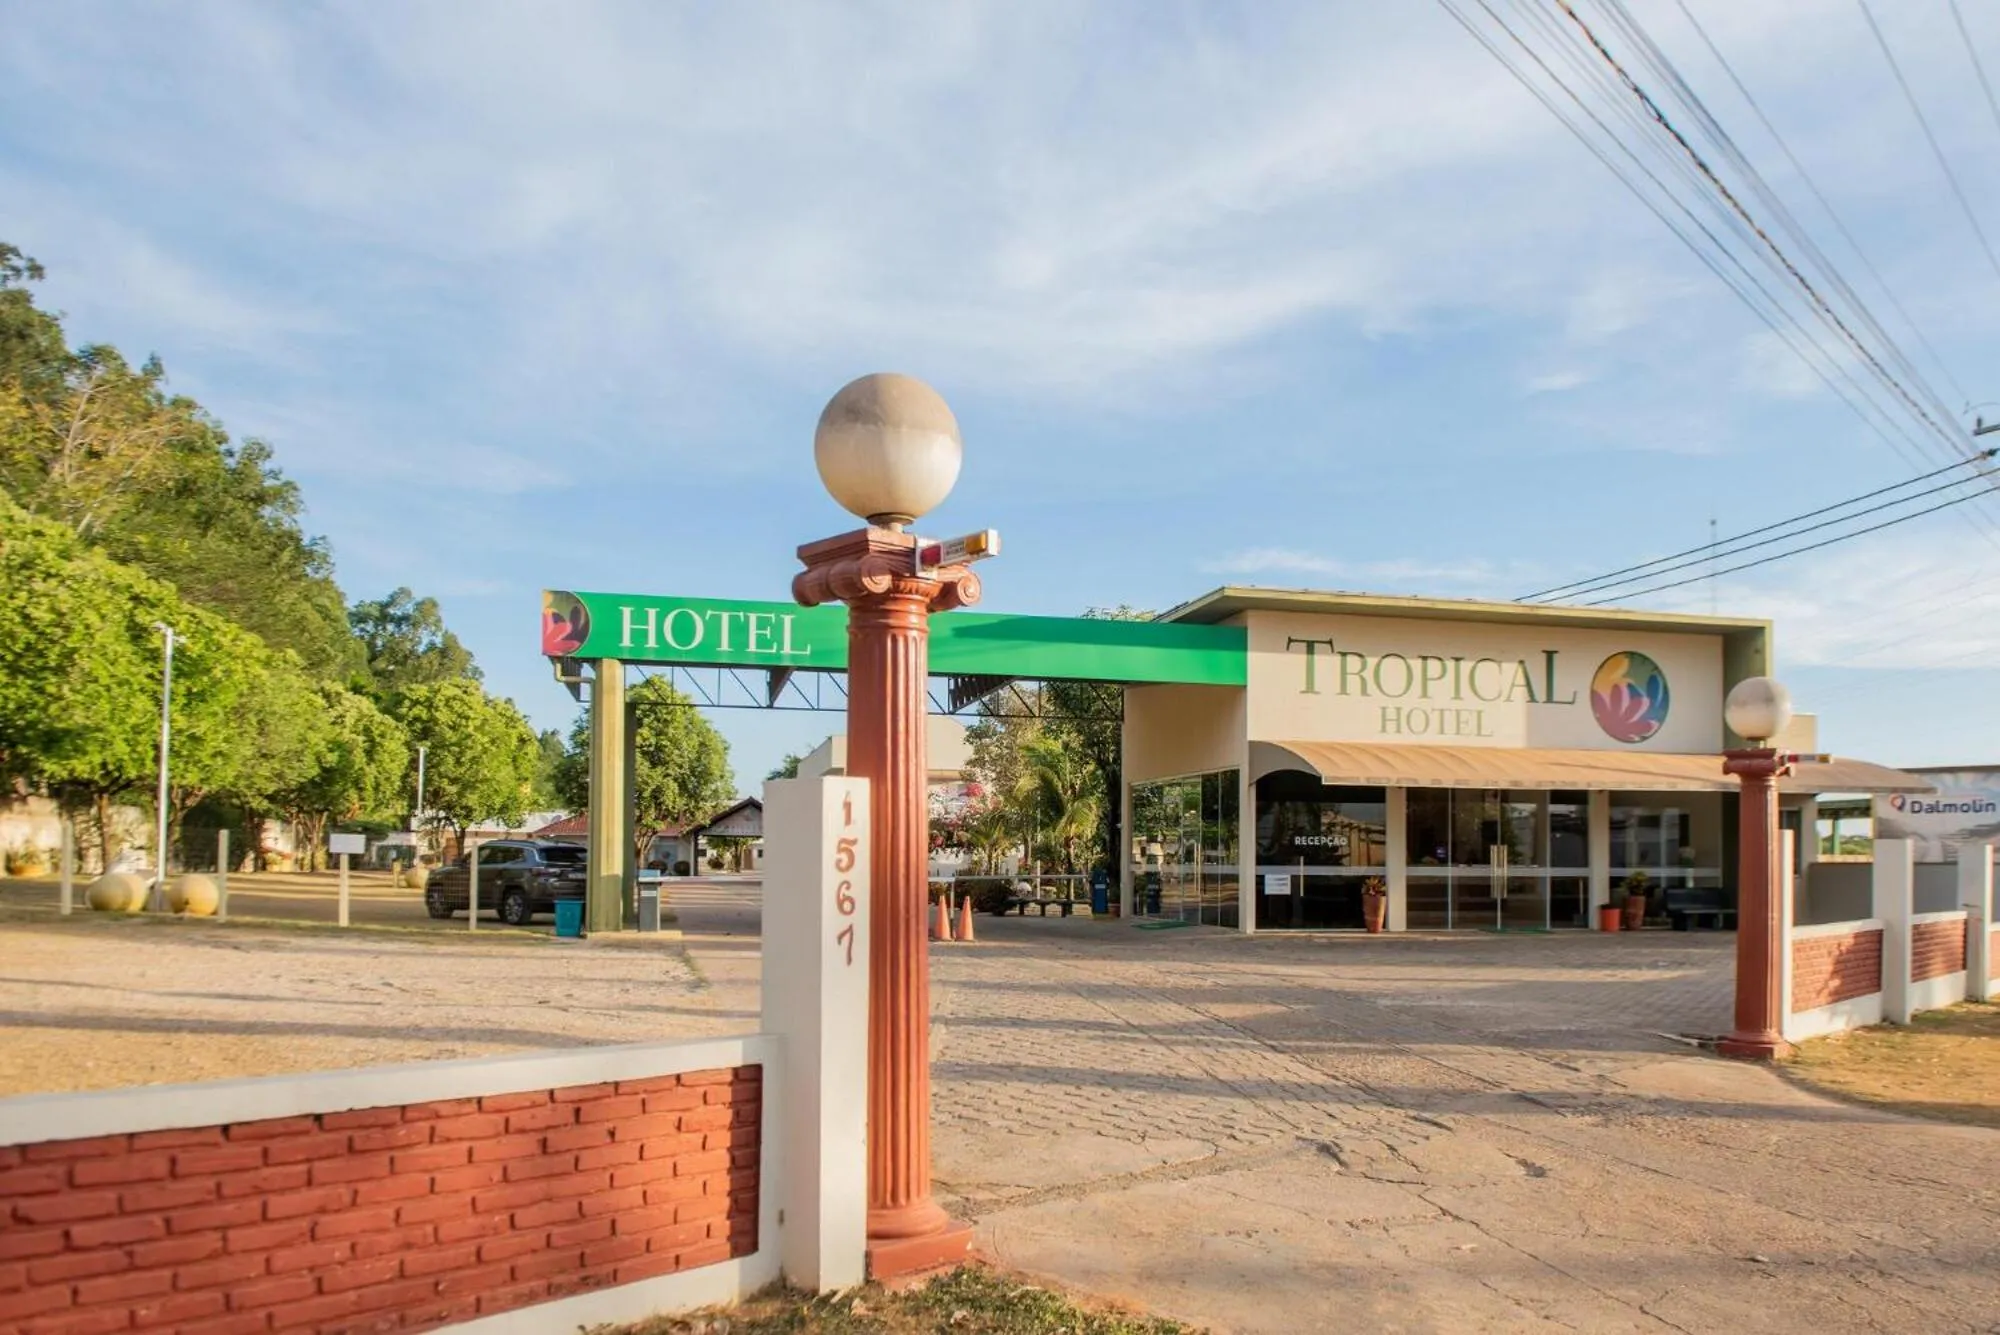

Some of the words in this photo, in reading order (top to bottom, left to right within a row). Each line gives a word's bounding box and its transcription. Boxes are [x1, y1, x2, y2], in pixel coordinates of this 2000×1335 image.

[618, 605, 812, 656] HOTEL
[1286, 636, 1577, 705] TROPICAL
[1379, 706, 1493, 737] HOTEL
[1910, 799, 1996, 814] Dalmolin
[834, 790, 859, 967] 1567
